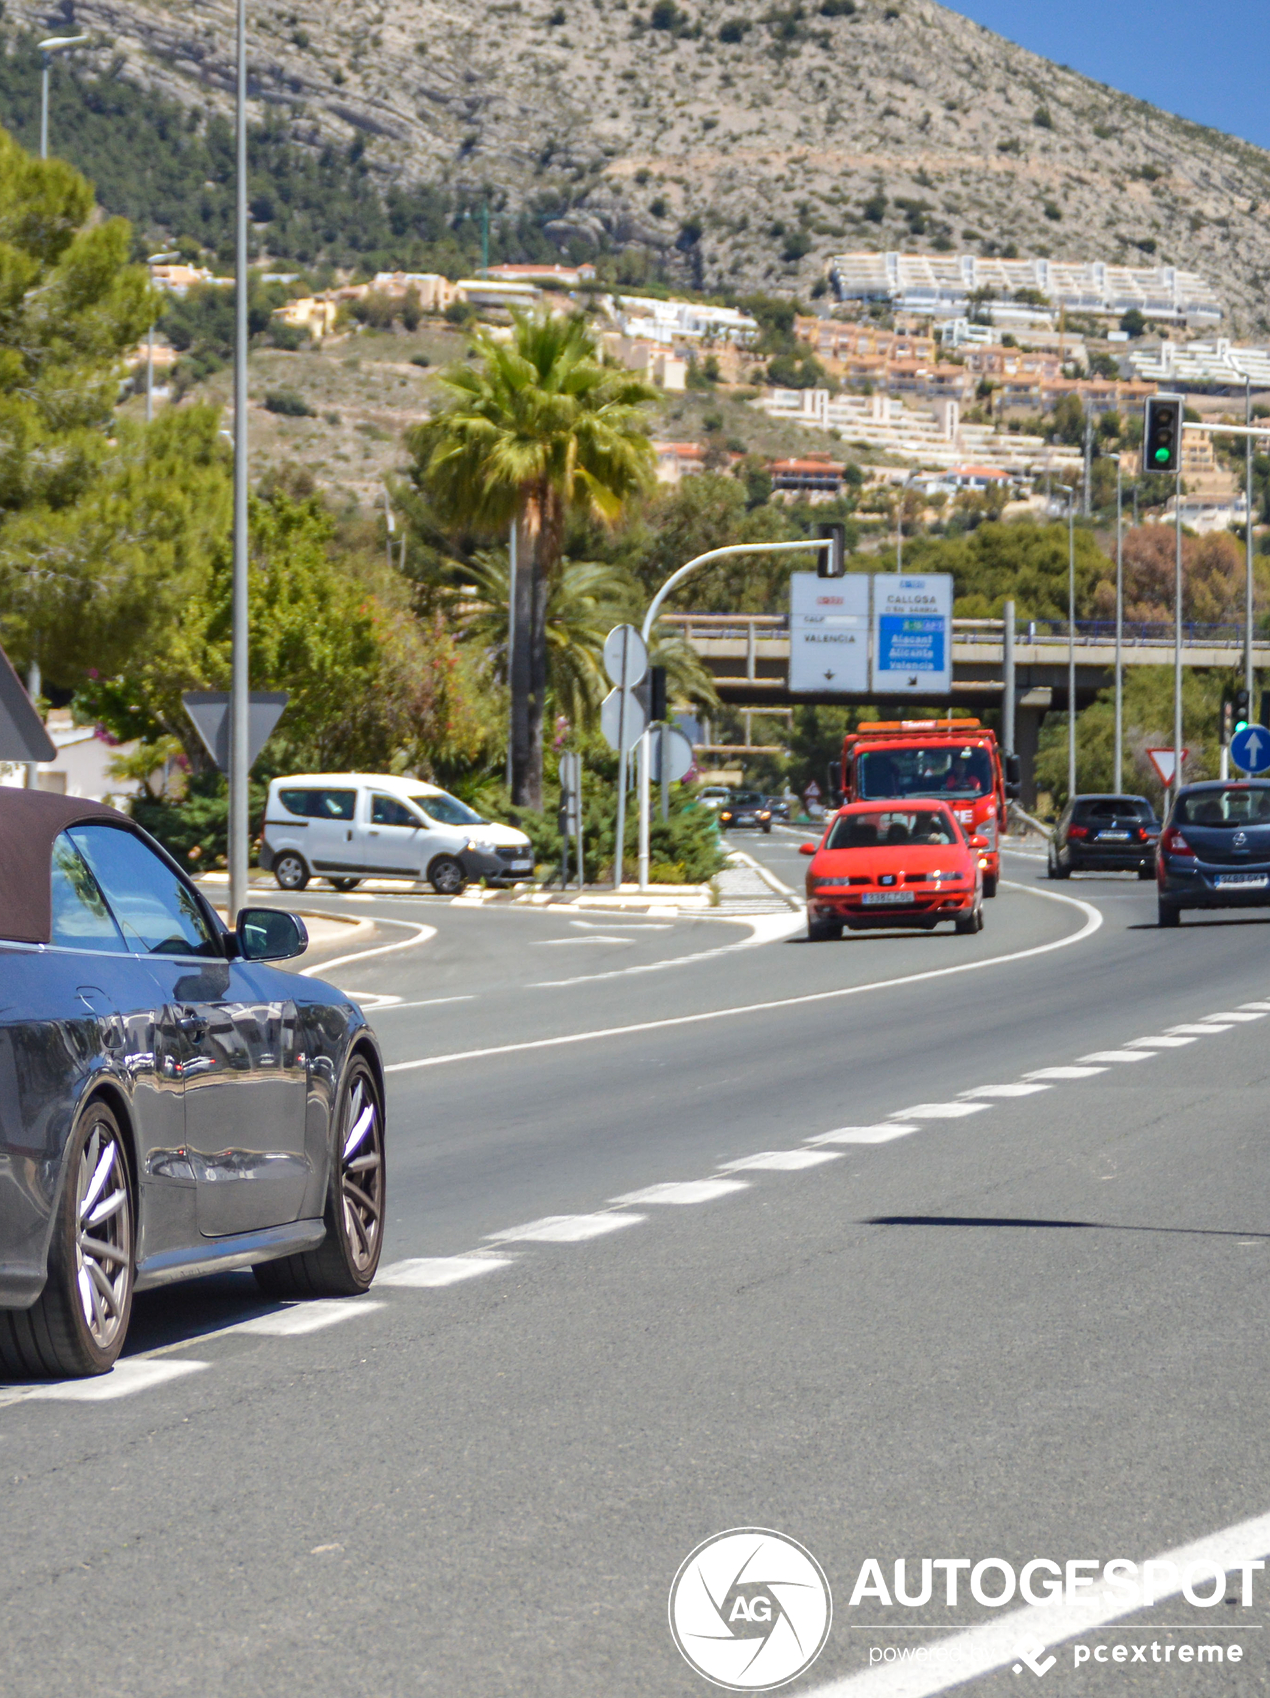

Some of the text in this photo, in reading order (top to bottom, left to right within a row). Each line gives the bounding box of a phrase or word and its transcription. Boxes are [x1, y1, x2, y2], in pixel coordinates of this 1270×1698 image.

[887, 595, 936, 604] CALLOSA
[804, 634, 855, 643] VALENCIA
[891, 634, 932, 643] Alacant
[889, 648, 934, 658] Alicante
[889, 661, 934, 670] Valencia
